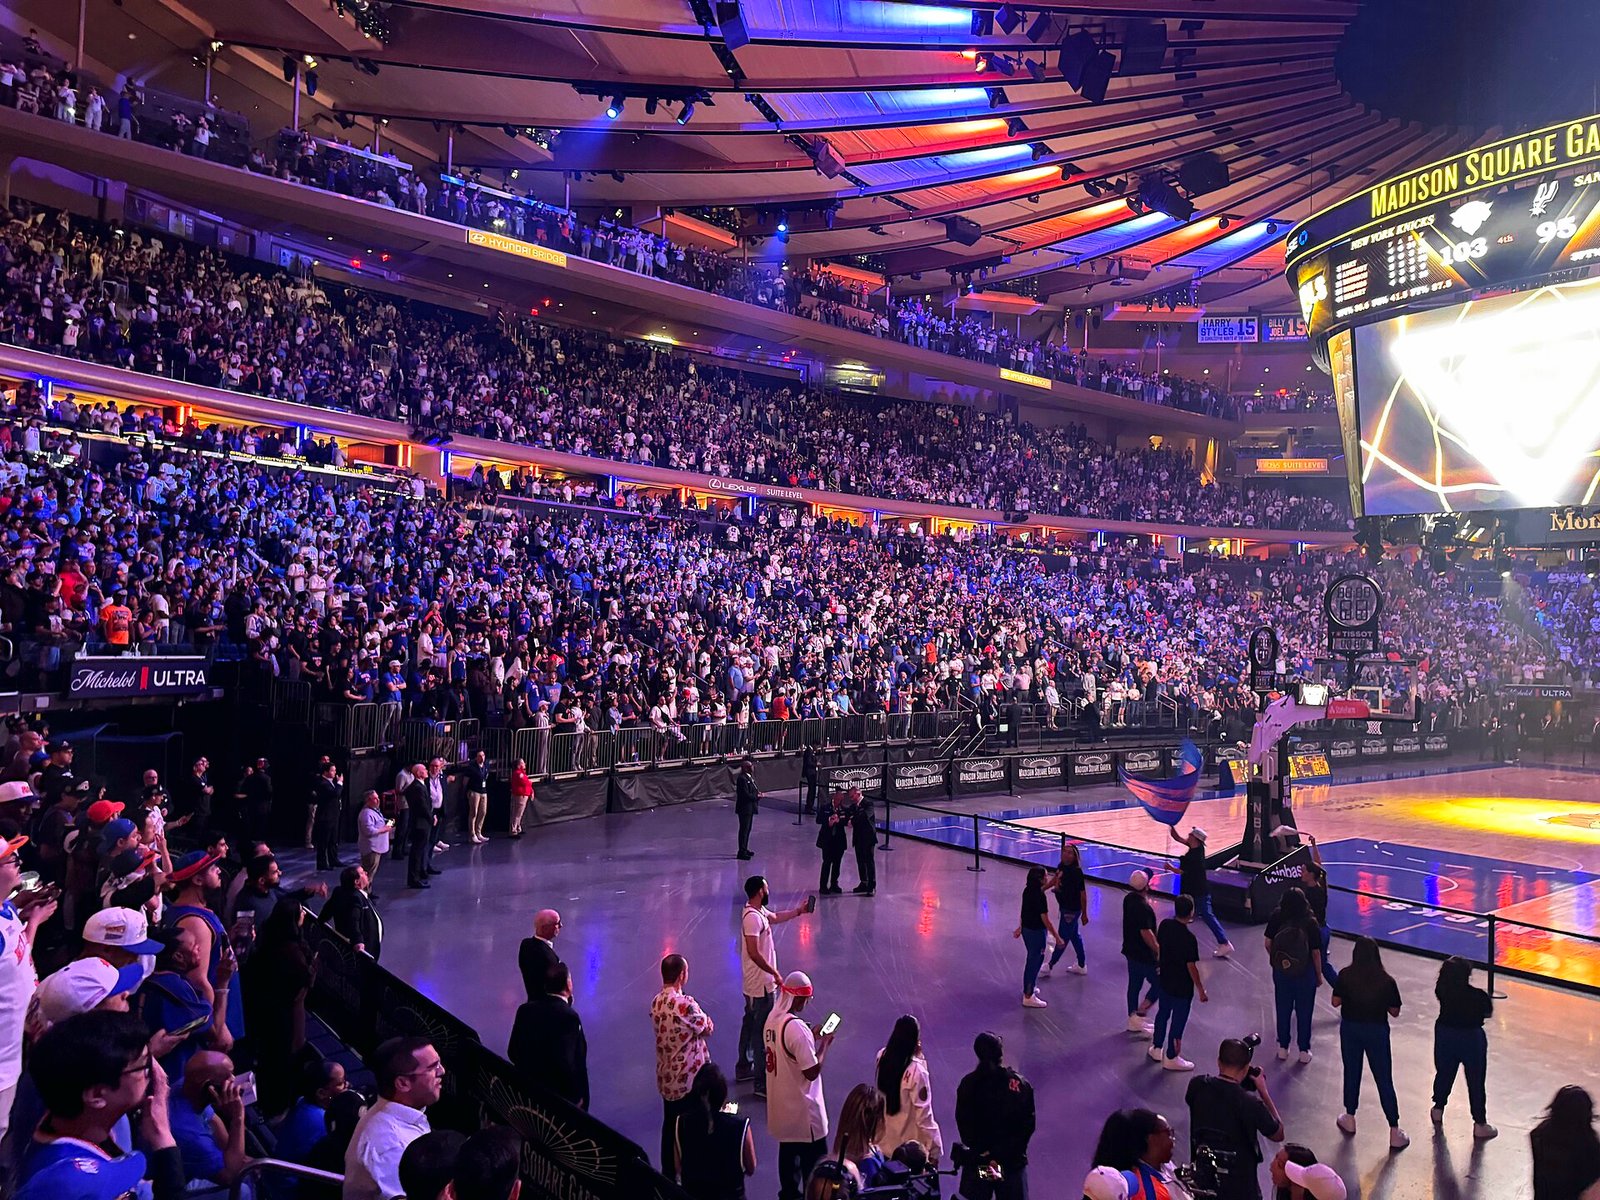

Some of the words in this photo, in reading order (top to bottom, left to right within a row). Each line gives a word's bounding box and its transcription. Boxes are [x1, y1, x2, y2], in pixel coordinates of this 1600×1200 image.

[1371, 161, 1458, 219] MADISON
[1465, 133, 1558, 186] SQUARE
[1350, 239, 1370, 251] NEW
[1370, 230, 1396, 244] YORK
[1396, 214, 1435, 234] KNICKS
[1535, 215, 1578, 245] 95
[1496, 234, 1514, 245] 4th
[488, 238, 531, 255] HYUNDAI
[532, 249, 565, 264] BRIDGE
[1439, 238, 1489, 268] 103
[1203, 318, 1232, 328] HARRY
[1237, 318, 1256, 336] 15
[1268, 318, 1286, 328] BILLY
[1287, 318, 1307, 336] 15
[1201, 327, 1234, 337] STYLES
[1269, 327, 1285, 337] JOEL
[1283, 461, 1301, 469] SUITE
[1304, 461, 1325, 469] LEVEL
[722, 483, 757, 493] LEXUS
[766, 488, 785, 498] SUITE
[785, 490, 803, 499] LEVEL
[1342, 630, 1373, 638] TISSOT
[71, 668, 137, 691] Michelob
[153, 670, 206, 687] ULTRA
[1541, 689, 1572, 697] ULTRA
[976, 770, 990, 780] SQUARE
[990, 769, 1005, 779] GARDEN
[1034, 766, 1048, 777] SQUARE
[1047, 765, 1062, 776] GARDEN
[865, 778, 882, 788] GARDEN
[895, 777, 913, 788] MADISON
[912, 775, 929, 786] SQUARE
[928, 774, 944, 785] GARDEN
[1253, 801, 1262, 843] NBA
[522, 1140, 565, 1200] SQUARE
